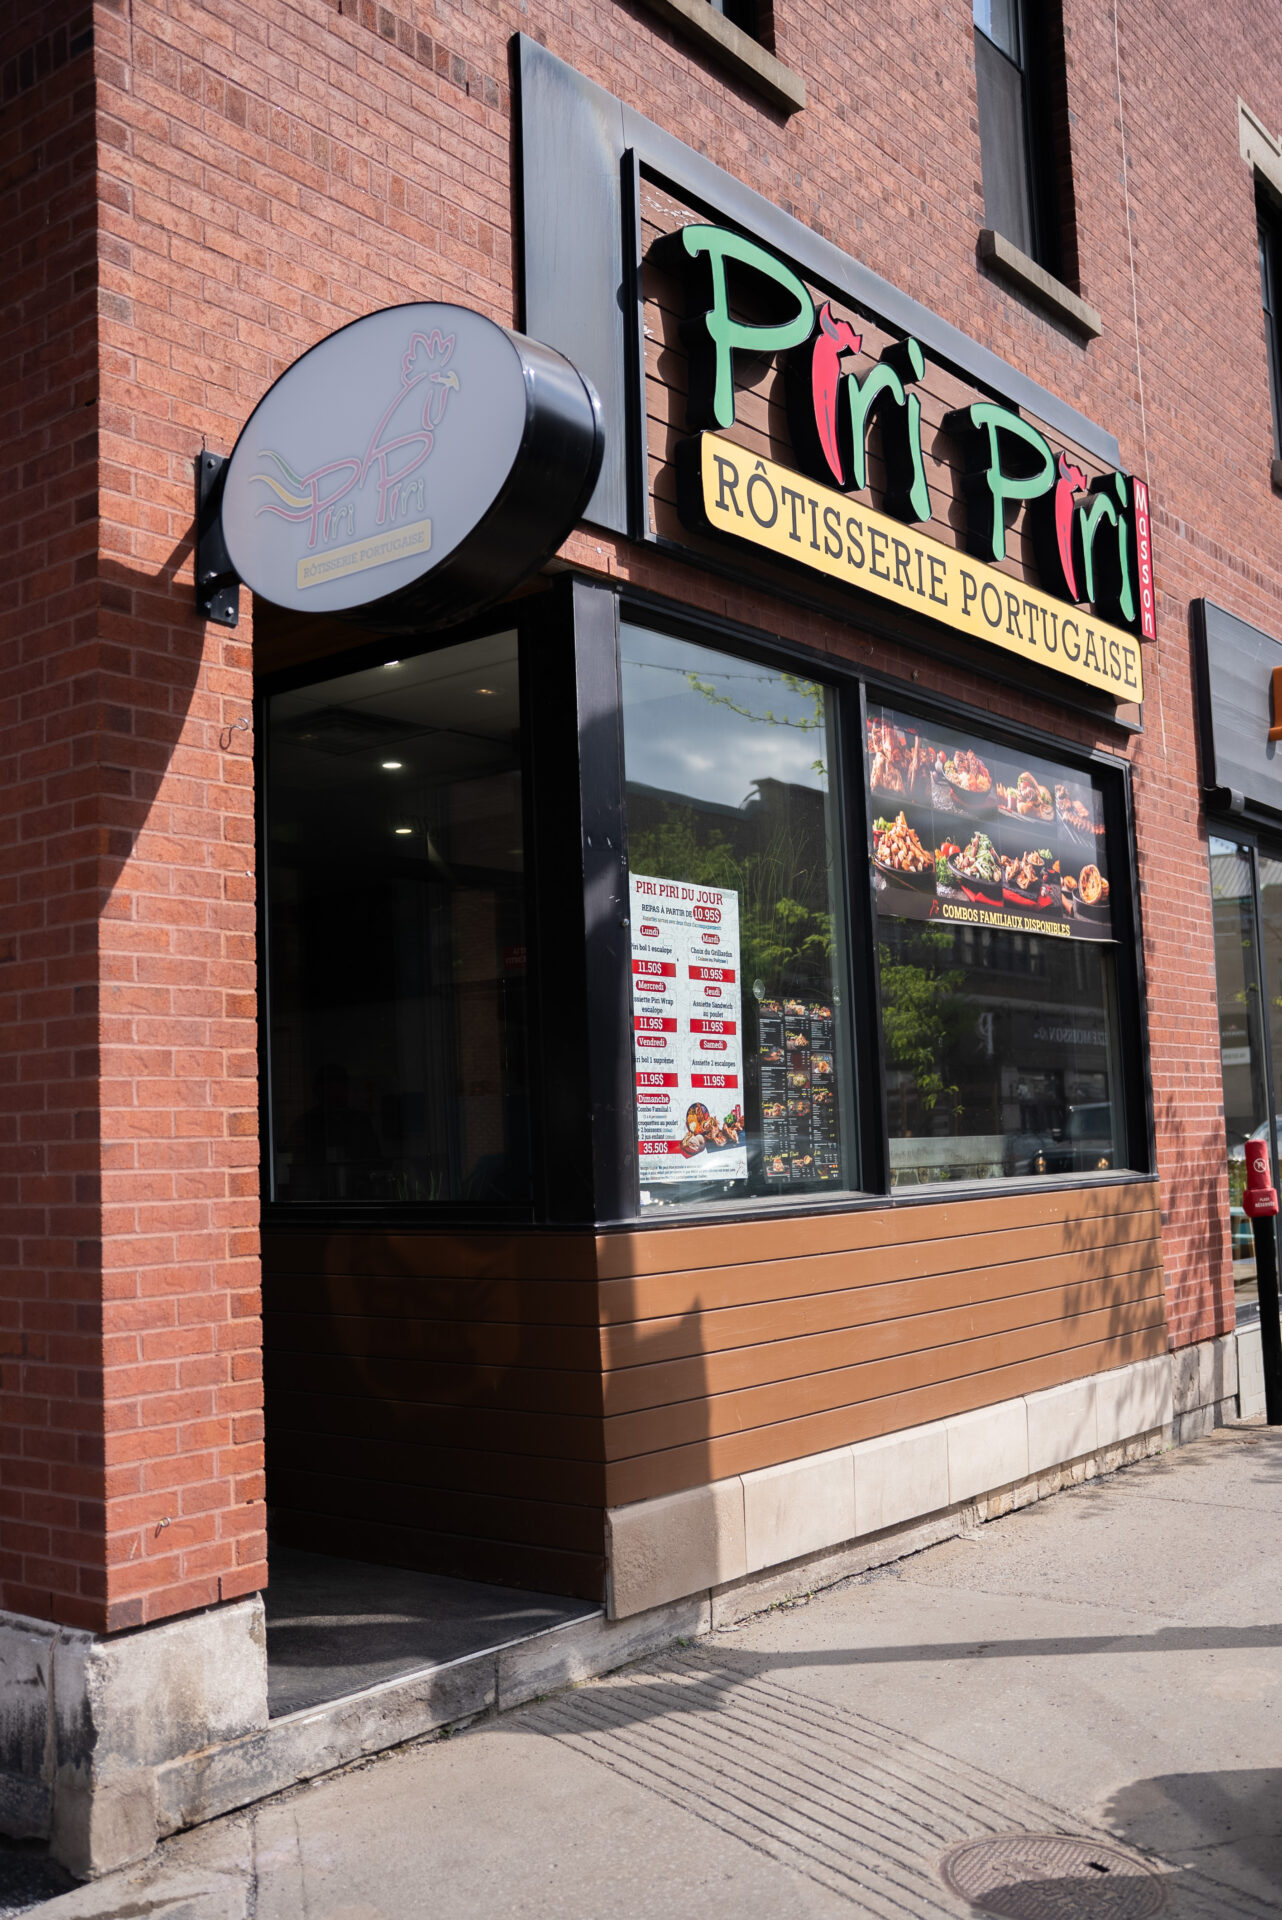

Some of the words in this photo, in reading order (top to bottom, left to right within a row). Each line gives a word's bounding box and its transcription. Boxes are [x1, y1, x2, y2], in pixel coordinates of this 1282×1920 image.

[682, 224, 932, 522] Piri
[970, 402, 1136, 622] Piri
[300, 457, 361, 548] Piri
[367, 430, 433, 525] Piri
[303, 551, 359, 579] RÔTISSERIE
[360, 530, 425, 562] PORTUGAISE
[1135, 484, 1154, 634] Masson
[713, 454, 949, 606] RÔTISSERIE
[960, 570, 1138, 688] PORTUGAISE
[636, 880, 656, 895] PIRI
[659, 884, 679, 899] PIRI
[681, 887, 695, 901] DU
[696, 890, 723, 905] JOUR
[641, 904, 659, 914] REPAS
[661, 905, 665, 914] À
[666, 908, 685, 917] PARTIR
[685, 910, 693, 918] DE
[694, 907, 720, 923] 10.95$
[942, 904, 979, 923] COMBOS
[980, 910, 1023, 929] FAMILIAUX
[1024, 918, 1071, 936] DISPONIBLES
[641, 927, 659, 936] Lundi
[703, 934, 719, 944] Mardi
[638, 961, 662, 975] 11.50$
[700, 968, 723, 980] 10.95$
[638, 981, 664, 991] Mercredi
[706, 987, 721, 996] Jeudi
[640, 1018, 663, 1030] 11.95$
[702, 1021, 724, 1032] 11.95$
[639, 1038, 665, 1047] Vendredi
[703, 1040, 723, 1049] Samedi
[640, 1073, 664, 1085] 11.95$
[703, 1075, 725, 1087] 11.95$
[638, 1094, 669, 1103] Dimanche
[643, 1142, 668, 1154] 35.50$
